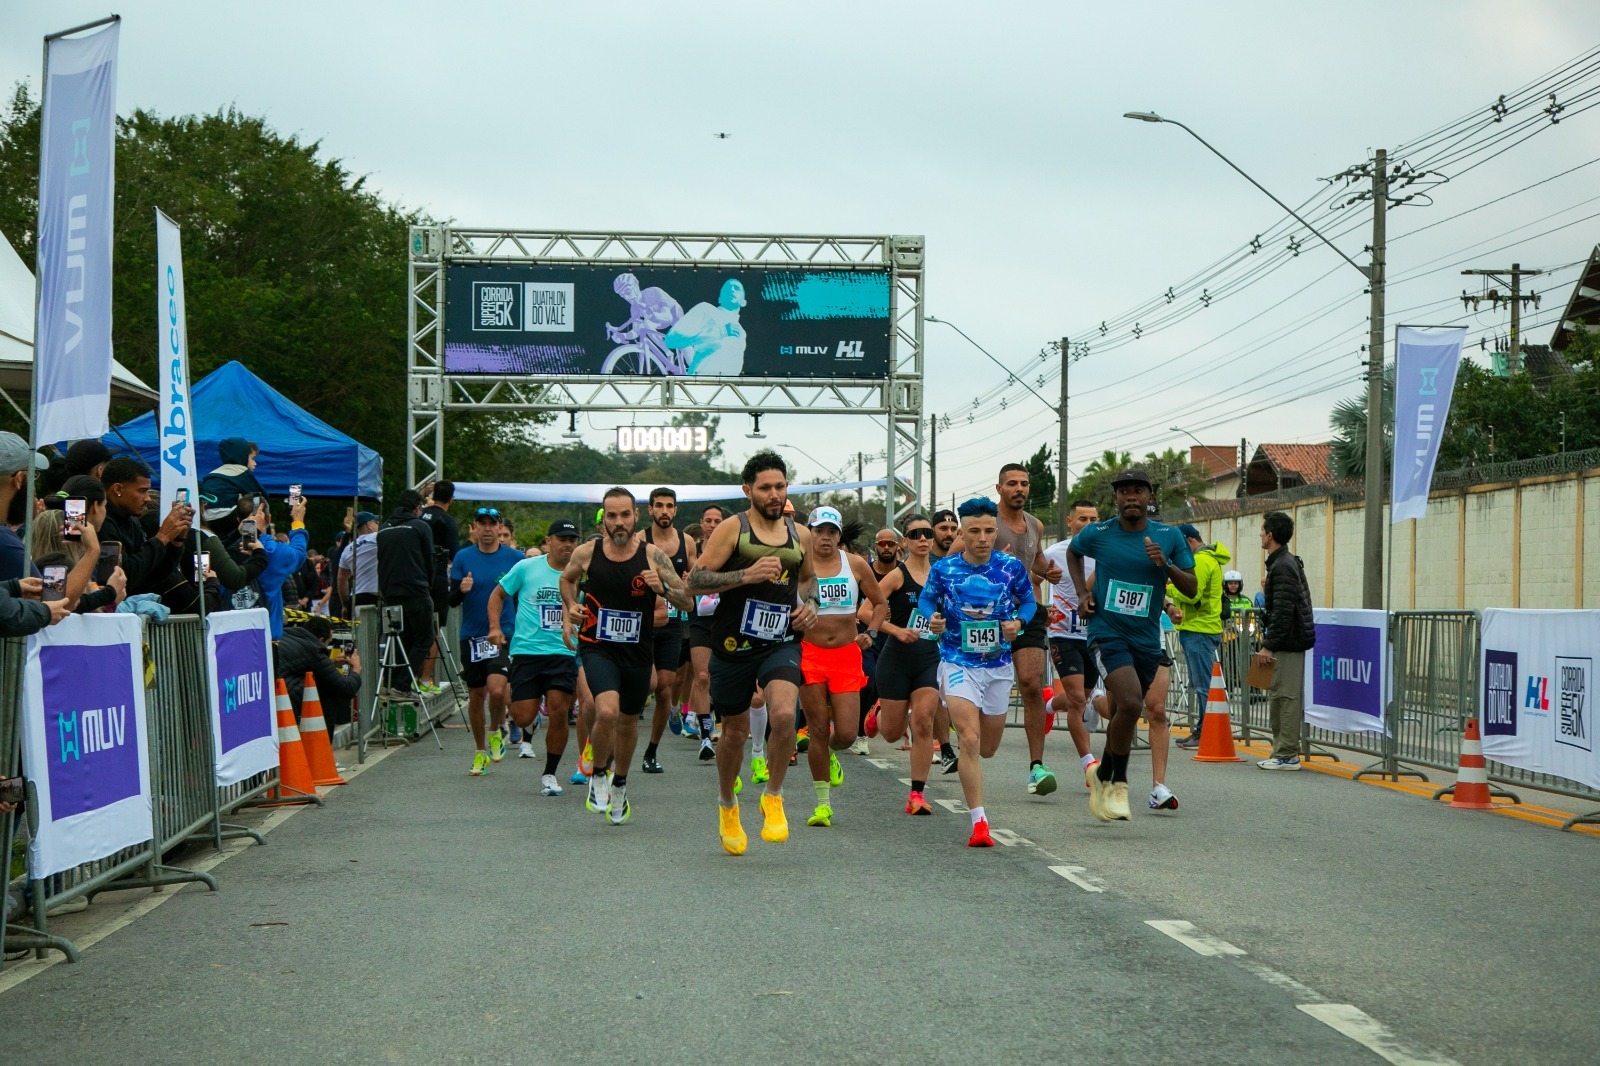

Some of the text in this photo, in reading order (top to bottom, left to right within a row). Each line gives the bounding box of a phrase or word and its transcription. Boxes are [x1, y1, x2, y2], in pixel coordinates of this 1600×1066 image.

[65, 194, 87, 355] MUV
[481, 286, 514, 302] CORRIDA
[532, 290, 566, 306] DUATHLON
[481, 301, 496, 326] SUPER
[495, 301, 514, 326] 5K
[532, 305, 566, 325] DO VALE
[795, 345, 828, 355] MUV
[162, 265, 187, 476] Abraceo
[820, 584, 847, 598] 5086
[1118, 590, 1144, 606] 5187
[546, 610, 563, 622] 100
[610, 617, 633, 633] 1010
[758, 611, 782, 630] 1107
[915, 615, 931, 631] 514
[970, 628, 996, 644] 5143
[1336, 657, 1372, 685] MUV
[1488, 662, 1512, 691] DUATHLON
[1561, 665, 1585, 694] CORRIDA
[237, 671, 262, 706] MUV
[1488, 690, 1512, 725] DO VALE
[1561, 691, 1572, 736] SUPER
[1571, 693, 1585, 740] 5K
[82, 704, 126, 754] MUV
